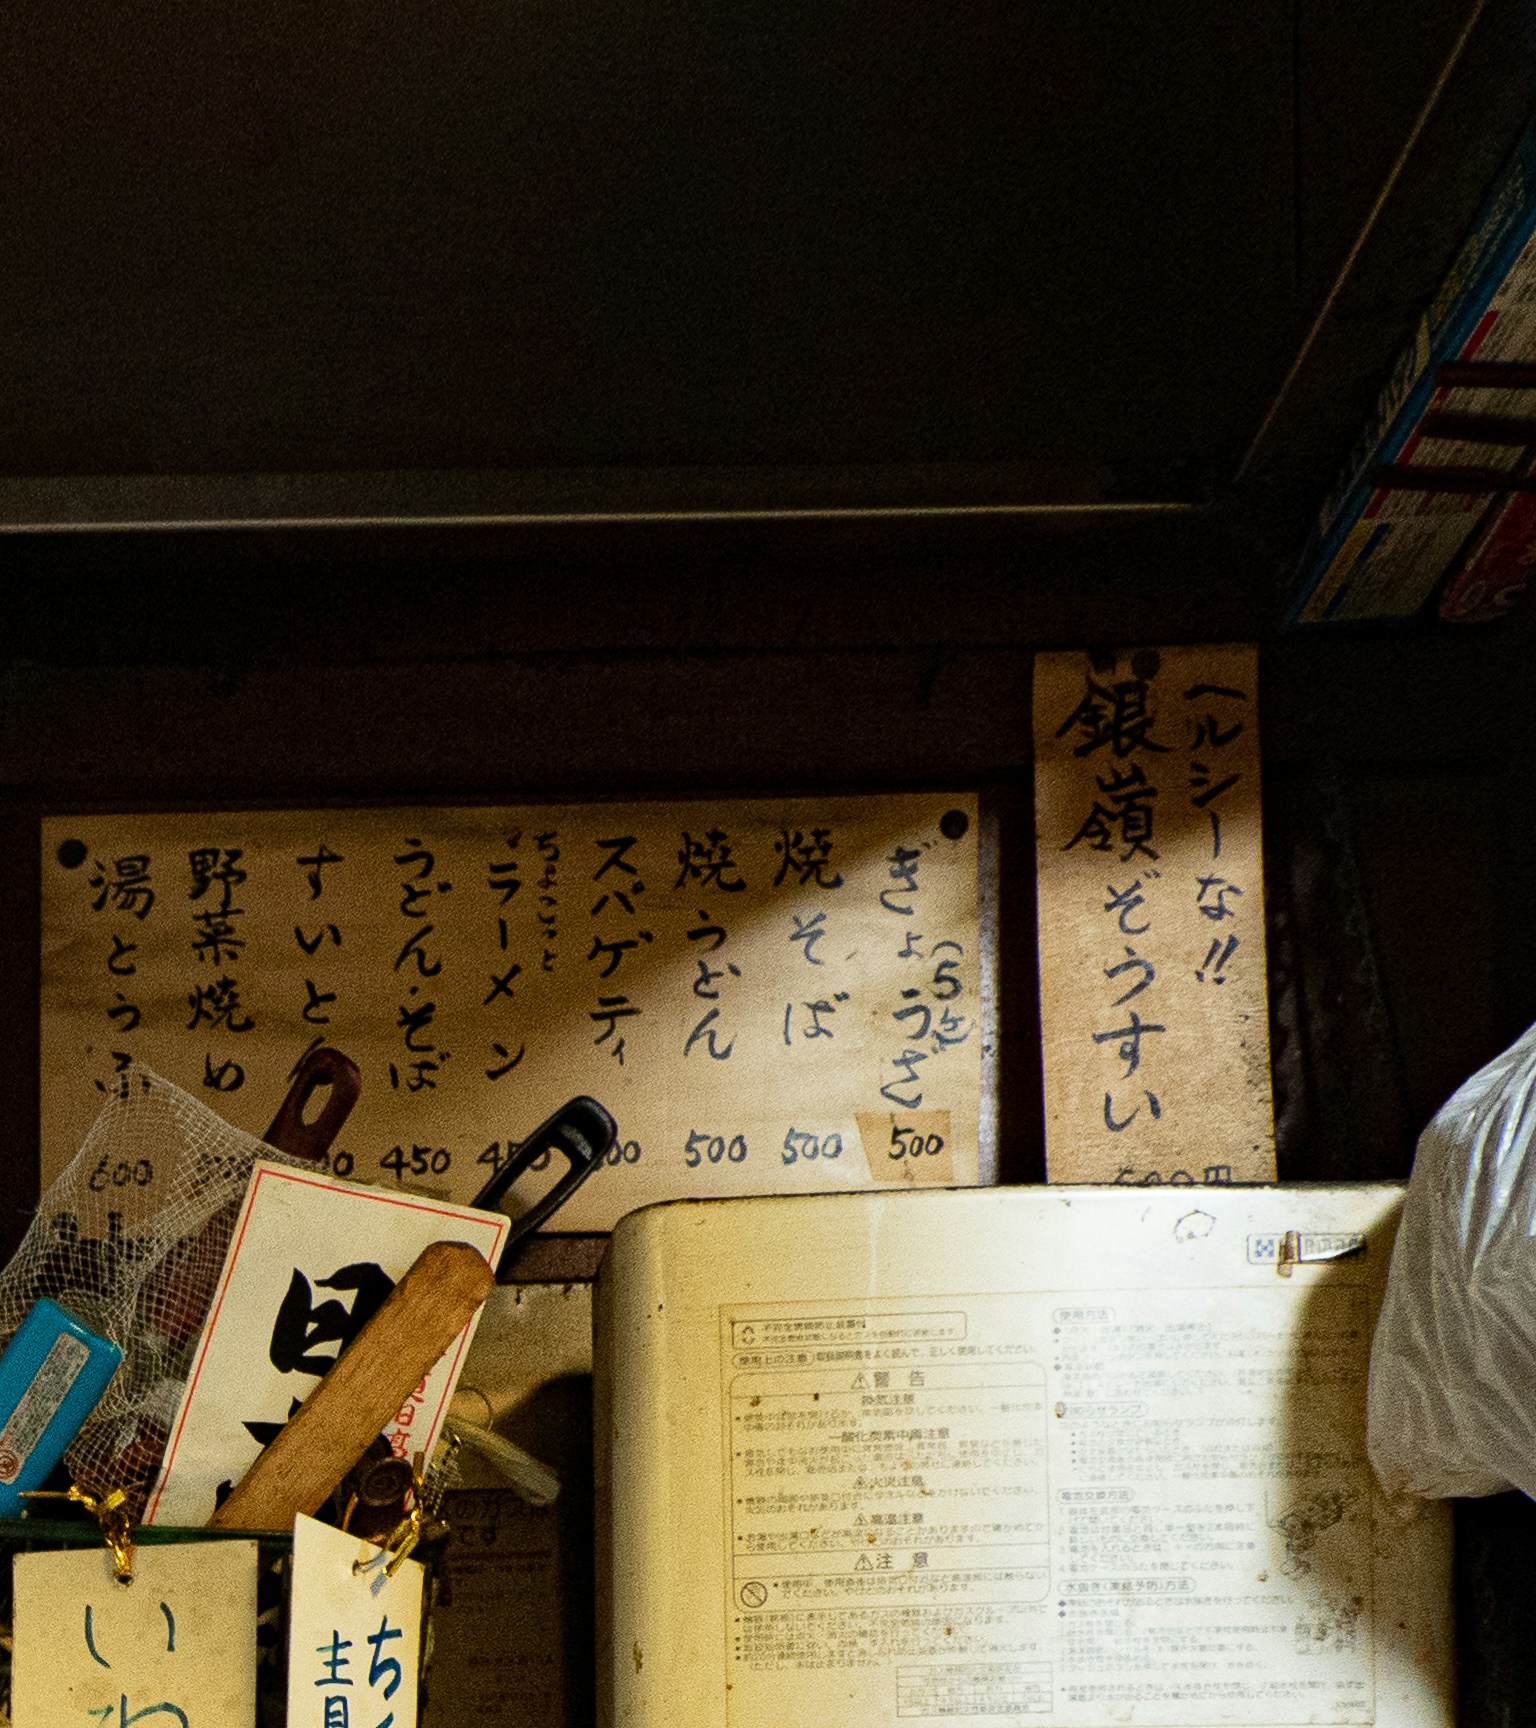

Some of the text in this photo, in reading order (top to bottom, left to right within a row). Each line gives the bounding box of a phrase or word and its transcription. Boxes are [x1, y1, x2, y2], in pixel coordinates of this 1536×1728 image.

[674, 830, 748, 1166] 焼うどん 500
[772, 827, 847, 1162] 焼そば 500
[379, 1147, 451, 1180] 450
[887, 1129, 945, 1161] 500
